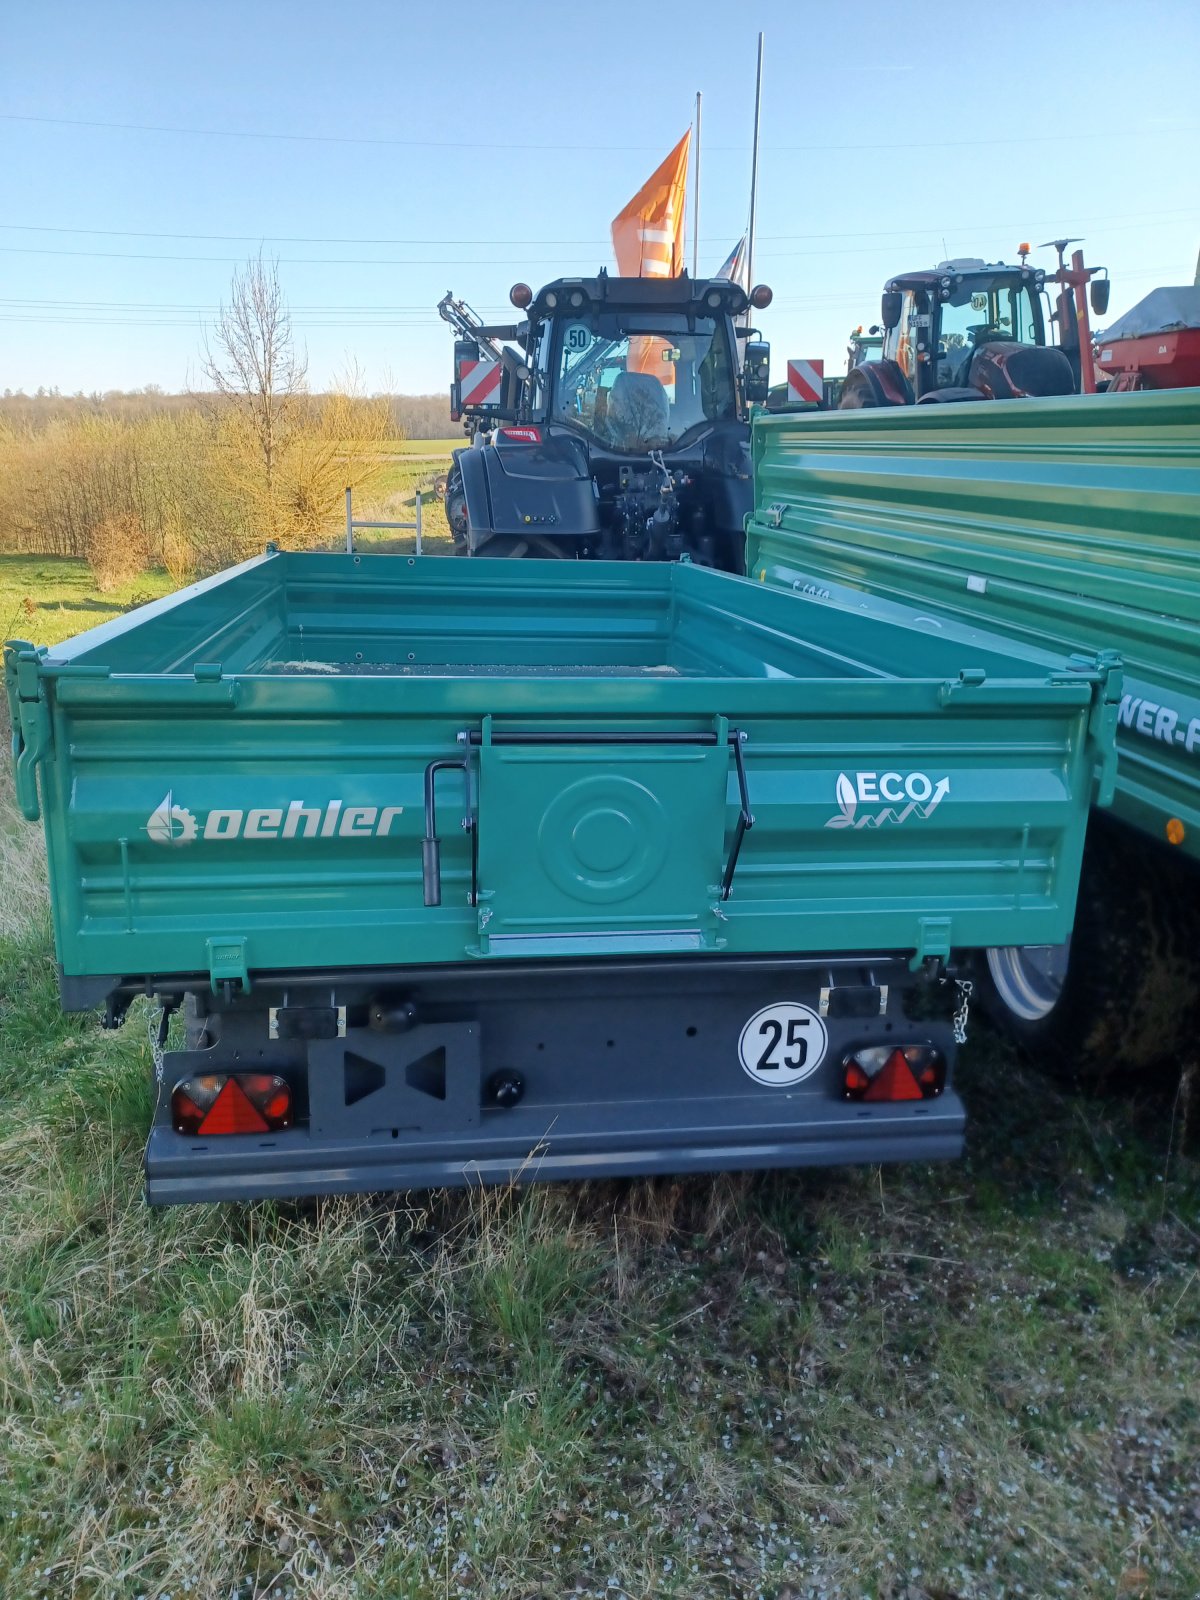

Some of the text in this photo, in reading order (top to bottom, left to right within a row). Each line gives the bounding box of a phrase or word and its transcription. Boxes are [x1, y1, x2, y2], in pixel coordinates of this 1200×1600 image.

[569, 329, 586, 348] 50
[856, 772, 932, 801] ECO
[203, 799, 404, 840] oehler
[756, 1018, 810, 1070] 25
